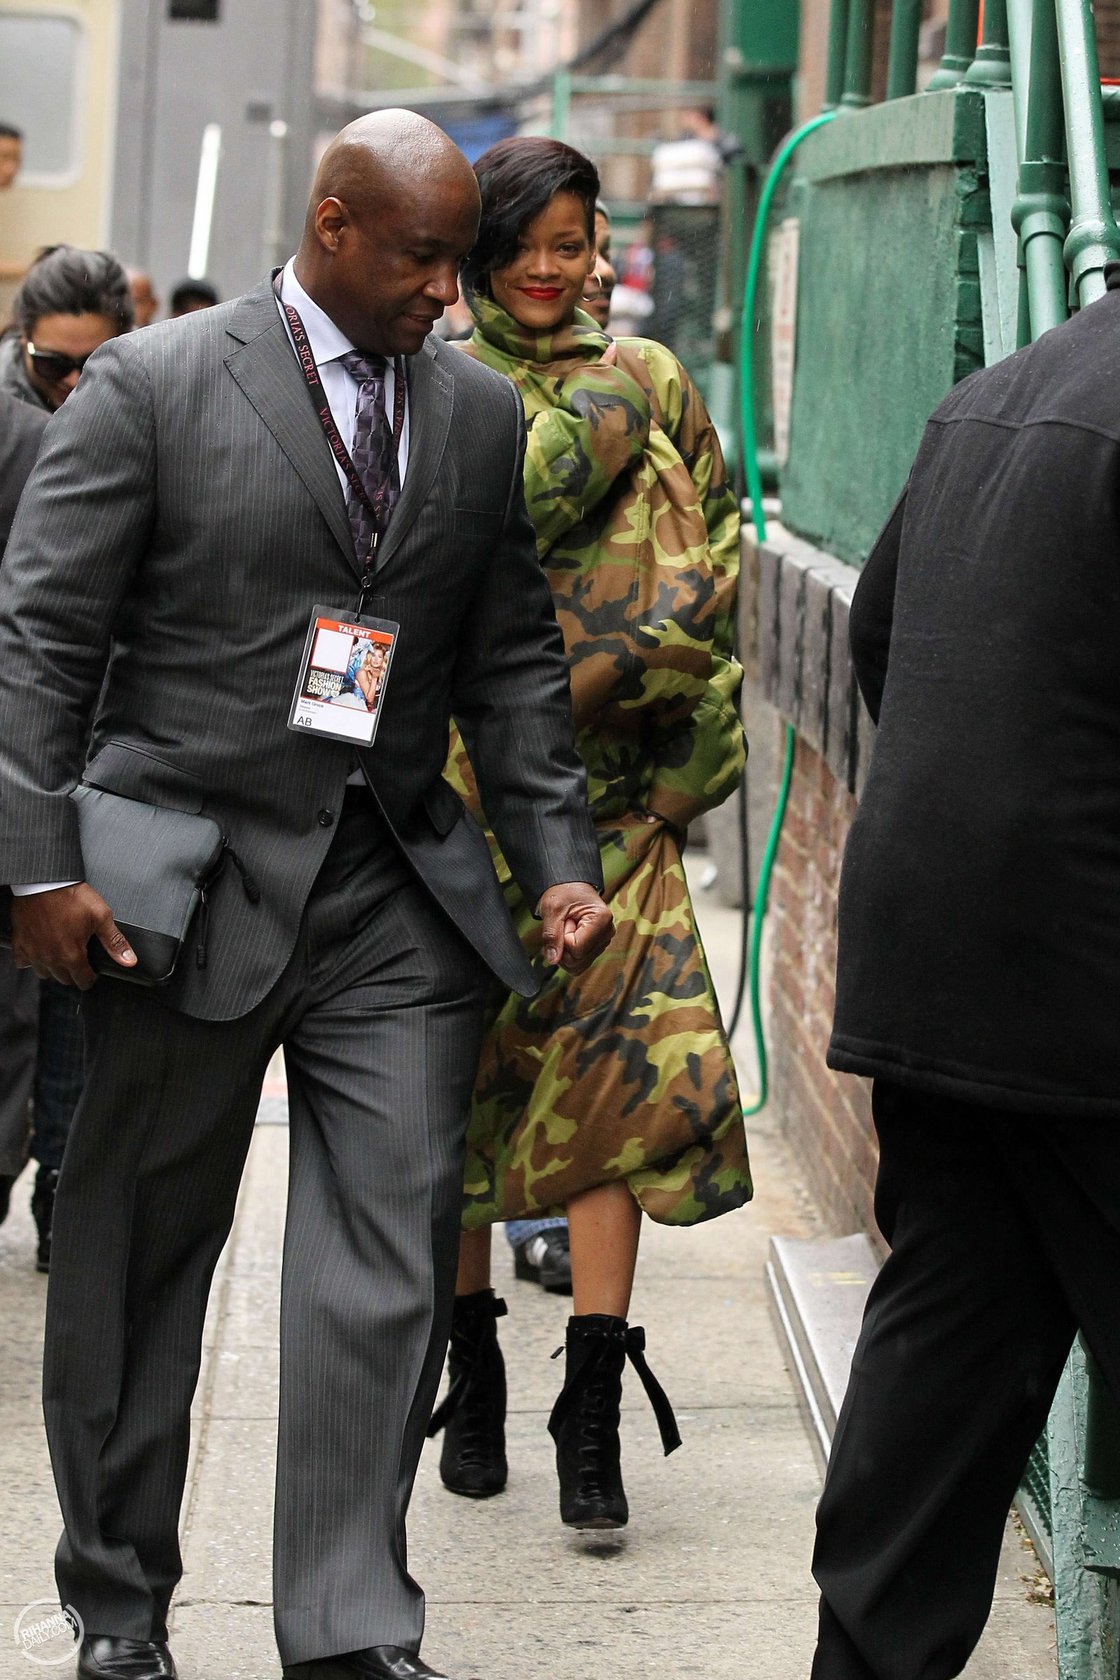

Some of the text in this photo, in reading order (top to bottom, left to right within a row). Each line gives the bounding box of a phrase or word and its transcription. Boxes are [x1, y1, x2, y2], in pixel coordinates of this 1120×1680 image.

[284, 304, 319, 385] ORIA'S SECRET
[319, 407, 350, 471] VICTORIA'S
[338, 624, 371, 638] TALENT
[307, 684, 331, 697] SHOW
[308, 676, 342, 691] FASHION
[296, 716, 313, 727] AB
